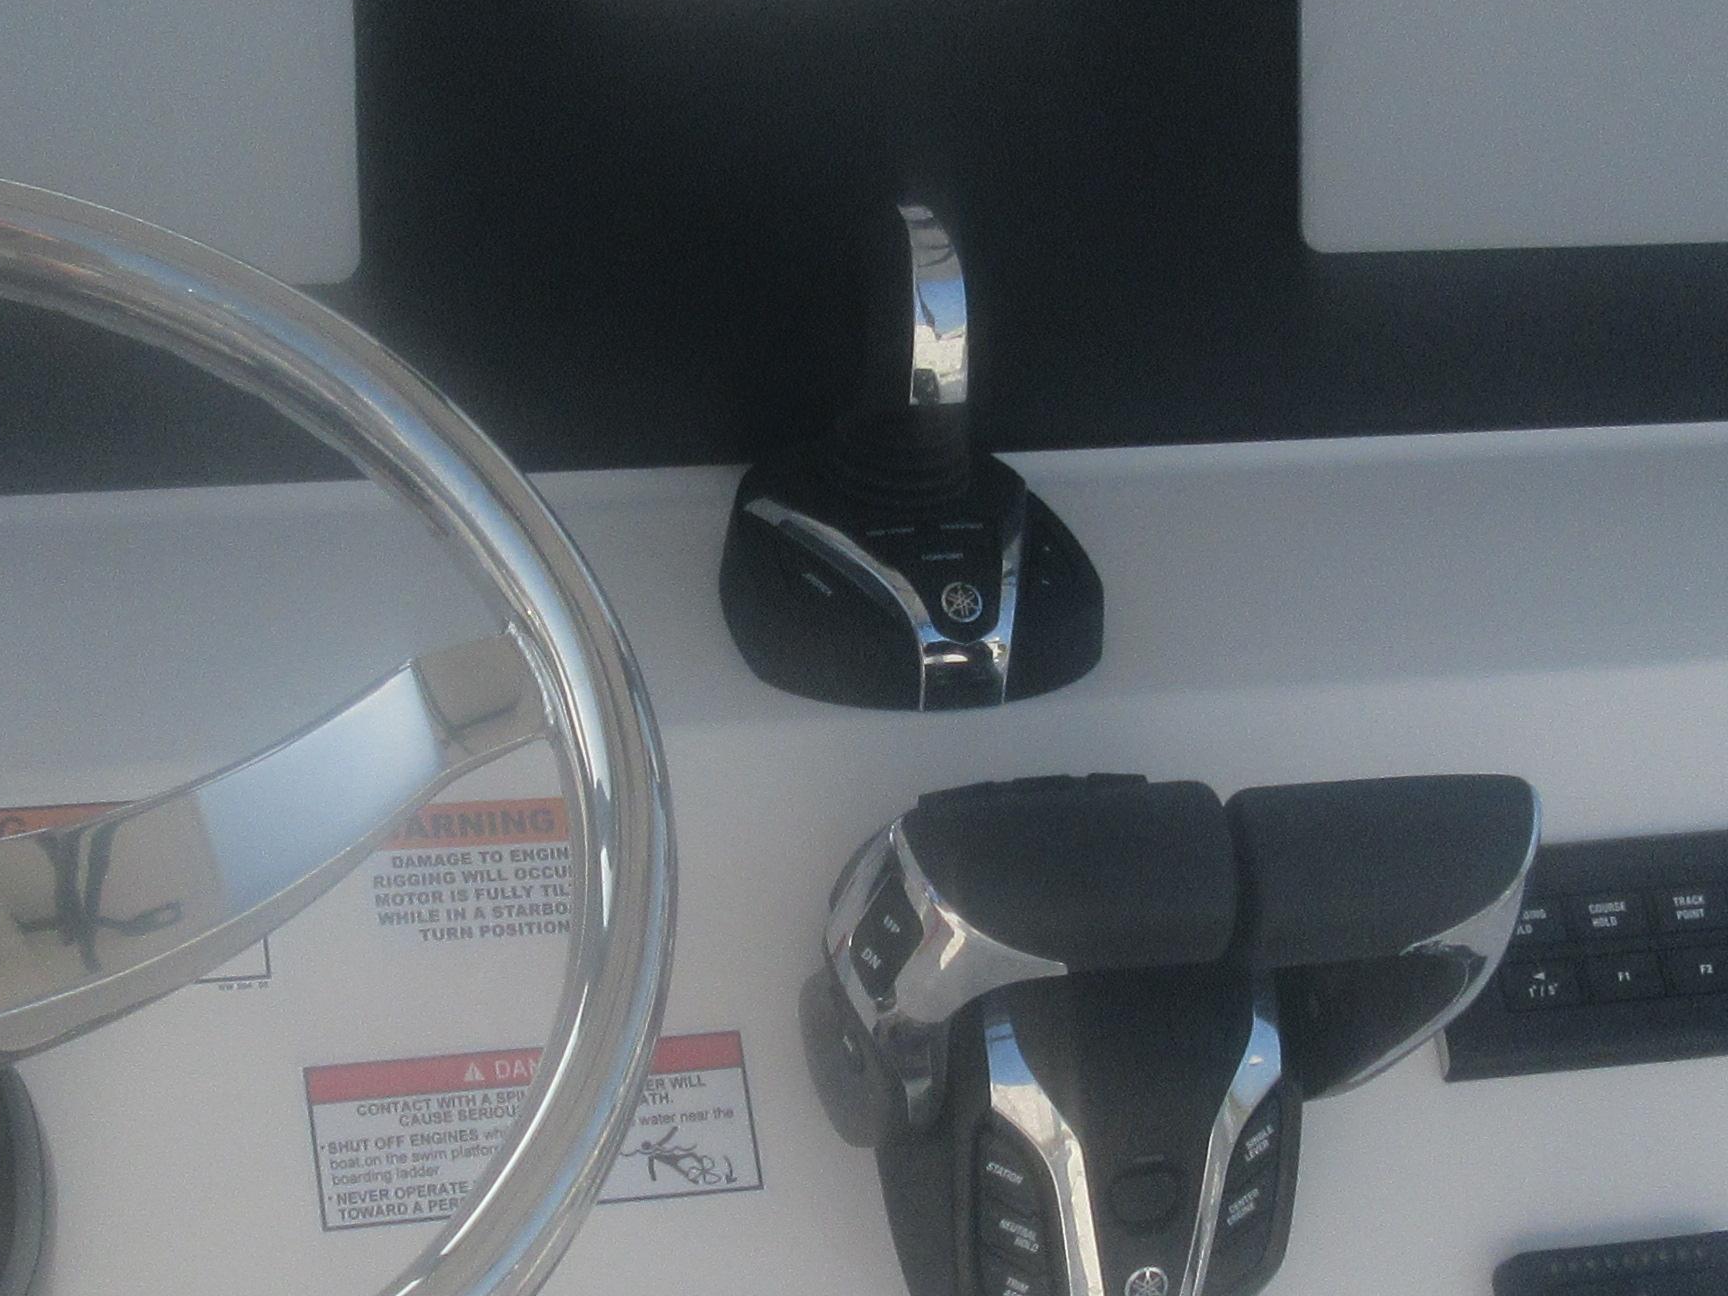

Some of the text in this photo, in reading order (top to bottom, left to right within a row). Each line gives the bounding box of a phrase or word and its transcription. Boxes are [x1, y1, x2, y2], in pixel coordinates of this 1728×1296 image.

[402, 808, 556, 838] ARNING
[391, 846, 570, 869] DAMAGE TO ENGIN
[372, 864, 572, 890] RIGGING WILL OCCU
[374, 891, 444, 908] MOTOR
[450, 888, 471, 903] IS
[474, 885, 533, 902] FULLY
[1588, 901, 1626, 915] COURSE
[1673, 894, 1705, 908] TRACK
[376, 901, 572, 927] WHILE IN A STARBO
[1591, 916, 1618, 929] HOLD
[1676, 908, 1705, 922] POINT
[418, 919, 571, 943] TURN POSITION
[860, 947, 882, 970] DN
[1700, 964, 1714, 976] F2
[1618, 971, 1631, 983] F1
[356, 1099, 432, 1117] CONTACT
[436, 1094, 477, 1110] WITH
[481, 1093, 492, 1106] A
[671, 1074, 707, 1089] WILL
[399, 1109, 454, 1128] CAUSE
[327, 1138, 369, 1155] SHUT
[374, 1135, 405, 1151] OFF
[409, 1128, 479, 1148] ENGINES
[639, 1112, 677, 1126] water
[680, 1110, 709, 1123] near
[713, 1106, 734, 1120] the
[385, 1152, 408, 1165] the
[412, 1149, 447, 1162] swim
[331, 1168, 394, 1186] boarding
[985, 1161, 1024, 1186] STATION
[336, 1181, 470, 1206] NEVER OPERATE
[338, 1202, 408, 1222] TOWARD
[412, 1201, 423, 1214] A
